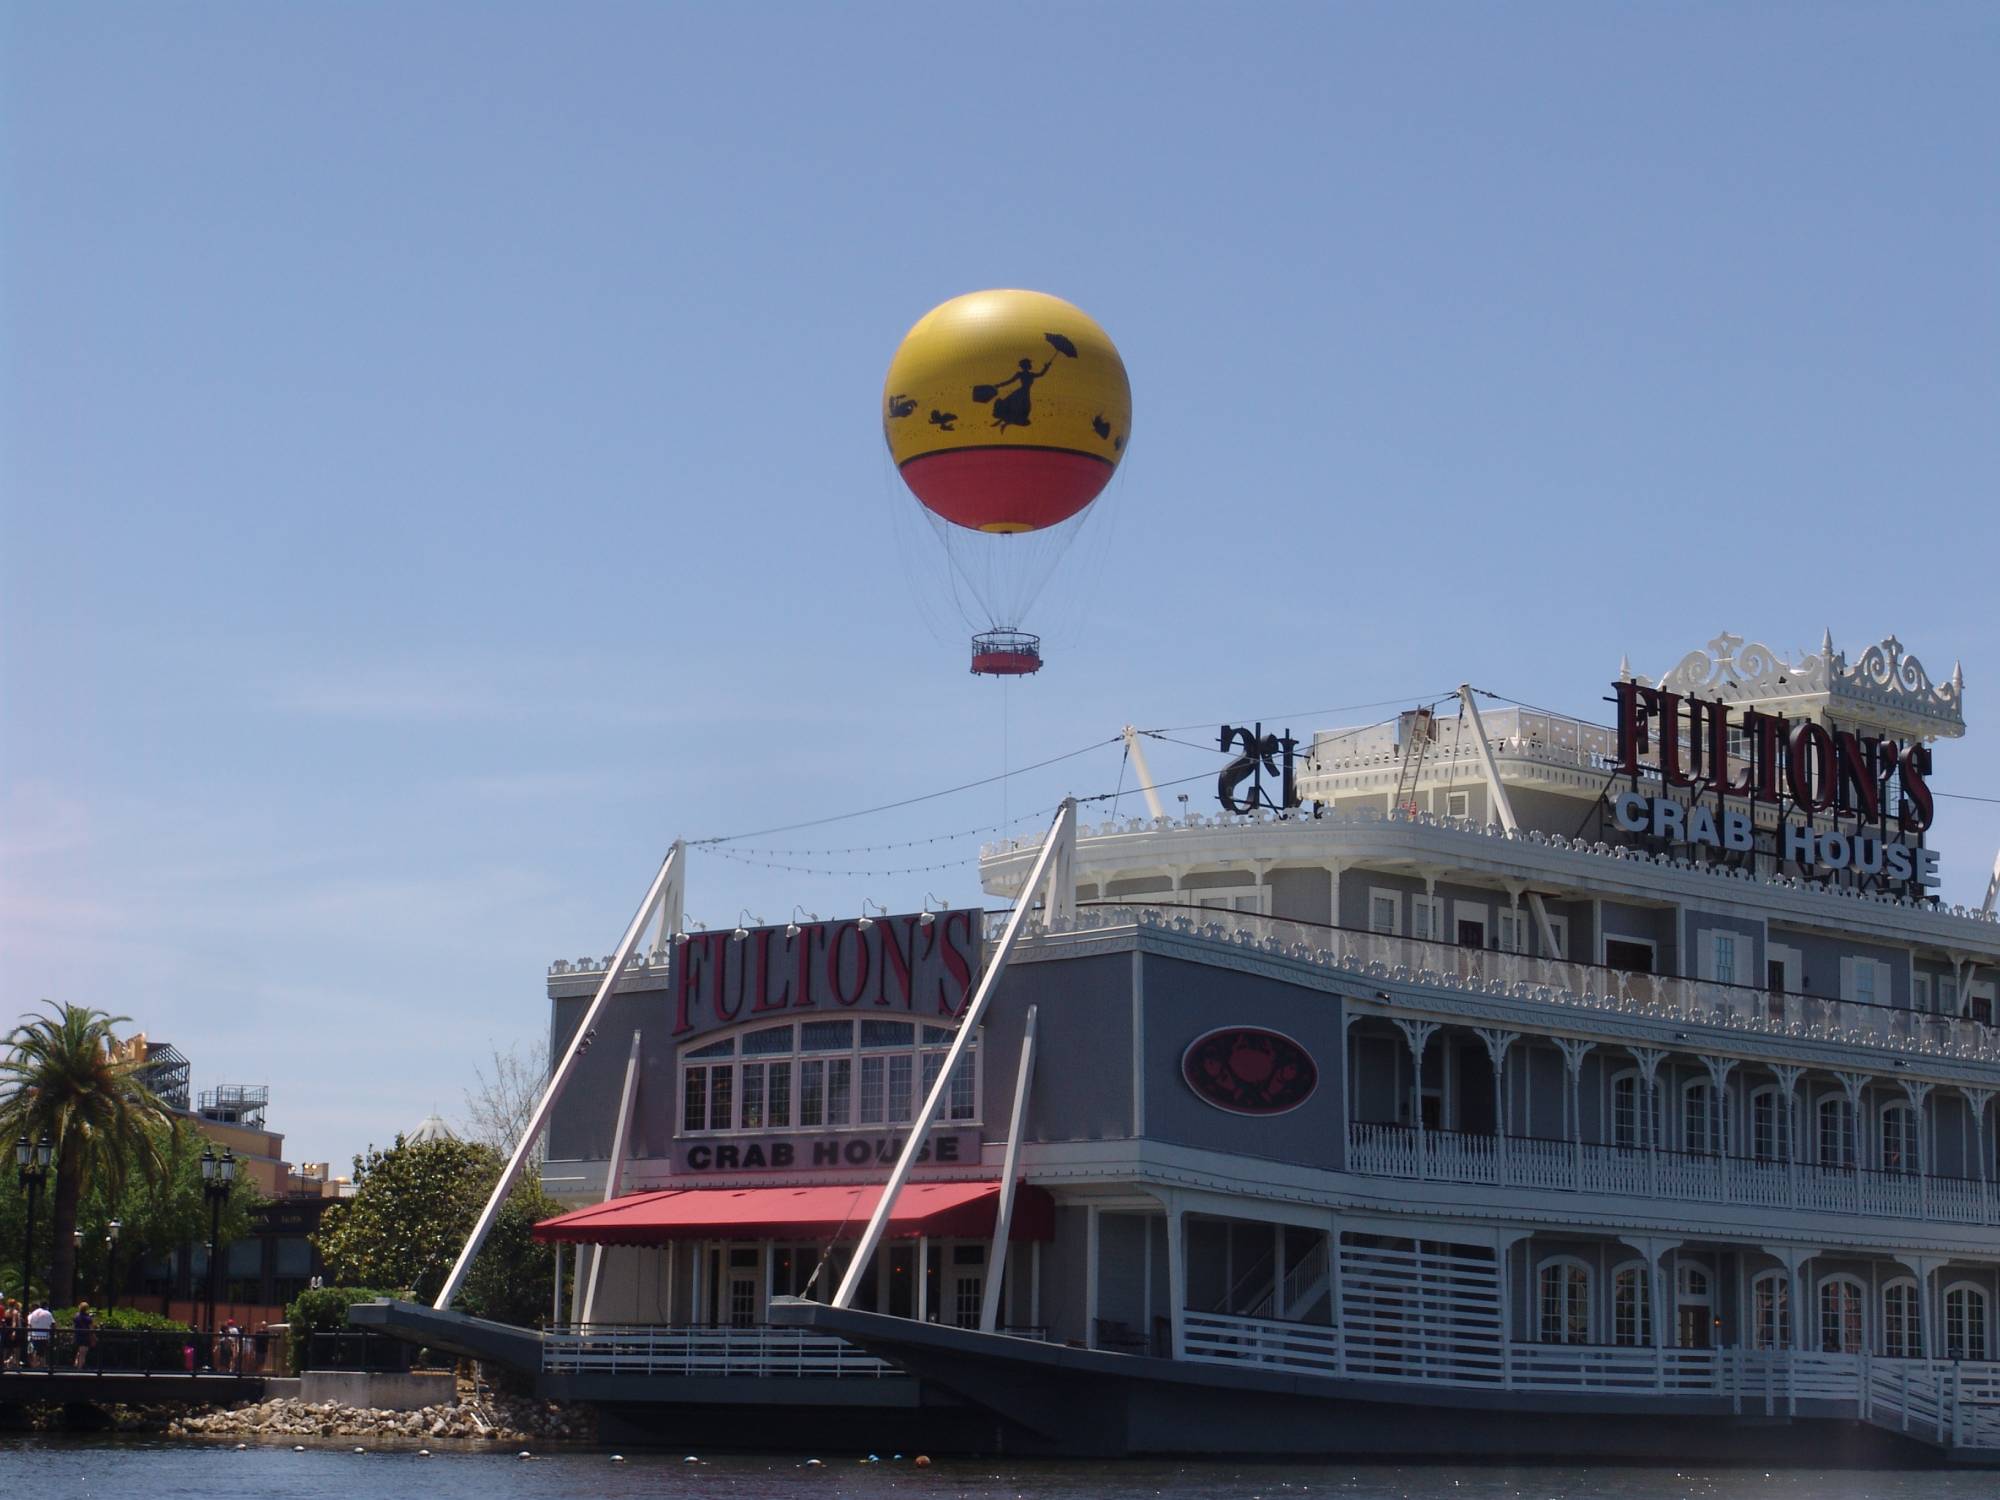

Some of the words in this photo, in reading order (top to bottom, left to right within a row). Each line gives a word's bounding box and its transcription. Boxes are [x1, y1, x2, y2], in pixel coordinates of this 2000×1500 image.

[1611, 681, 1934, 834] FULTON'S
[1614, 791, 1754, 851] CRAB
[1780, 824, 1942, 887] HOUSE
[672, 911, 972, 1036] FULTON'S
[687, 1142, 795, 1170] CRAB
